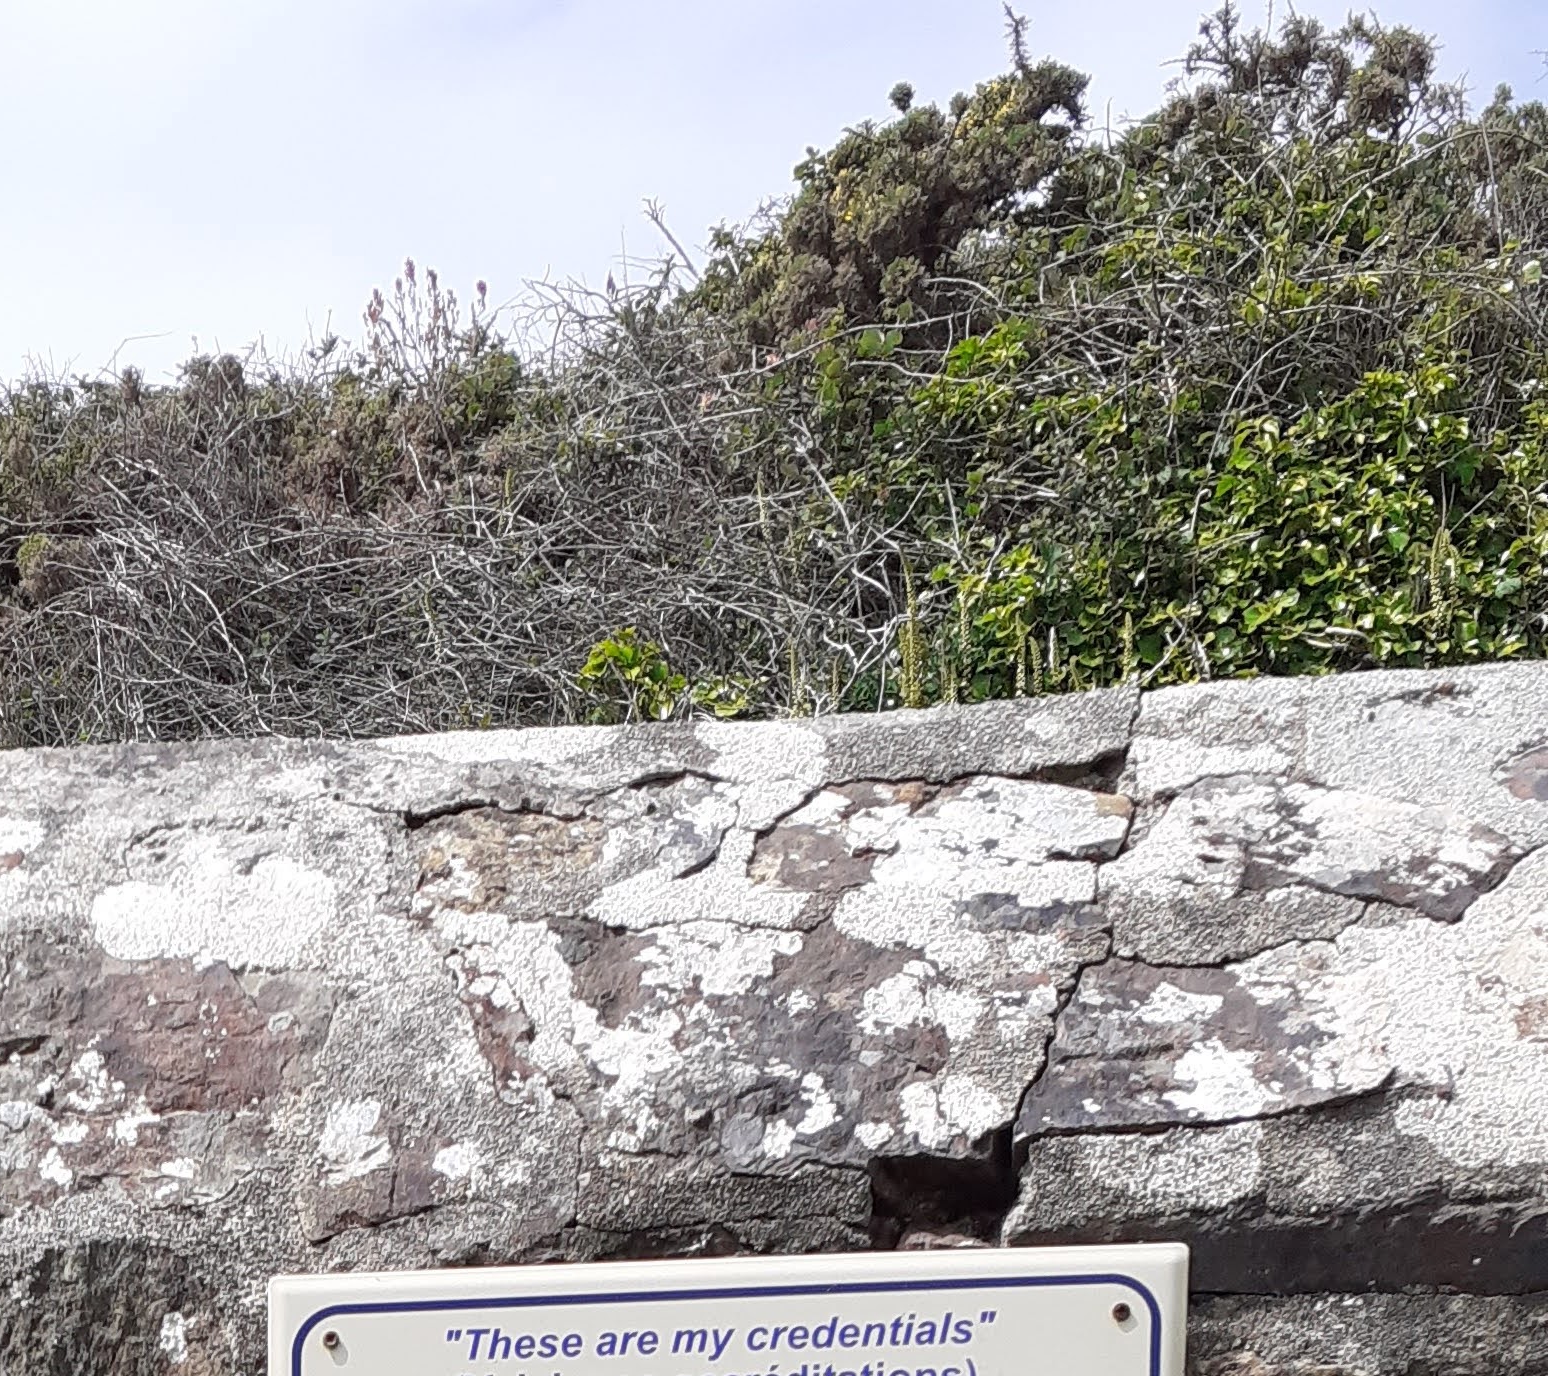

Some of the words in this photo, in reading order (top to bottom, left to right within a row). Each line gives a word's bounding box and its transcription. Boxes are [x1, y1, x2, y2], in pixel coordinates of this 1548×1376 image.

[446, 1327, 583, 1361] "These
[595, 1330, 659, 1357] are
[671, 1328, 736, 1362] my
[746, 1310, 997, 1352] credentials"
